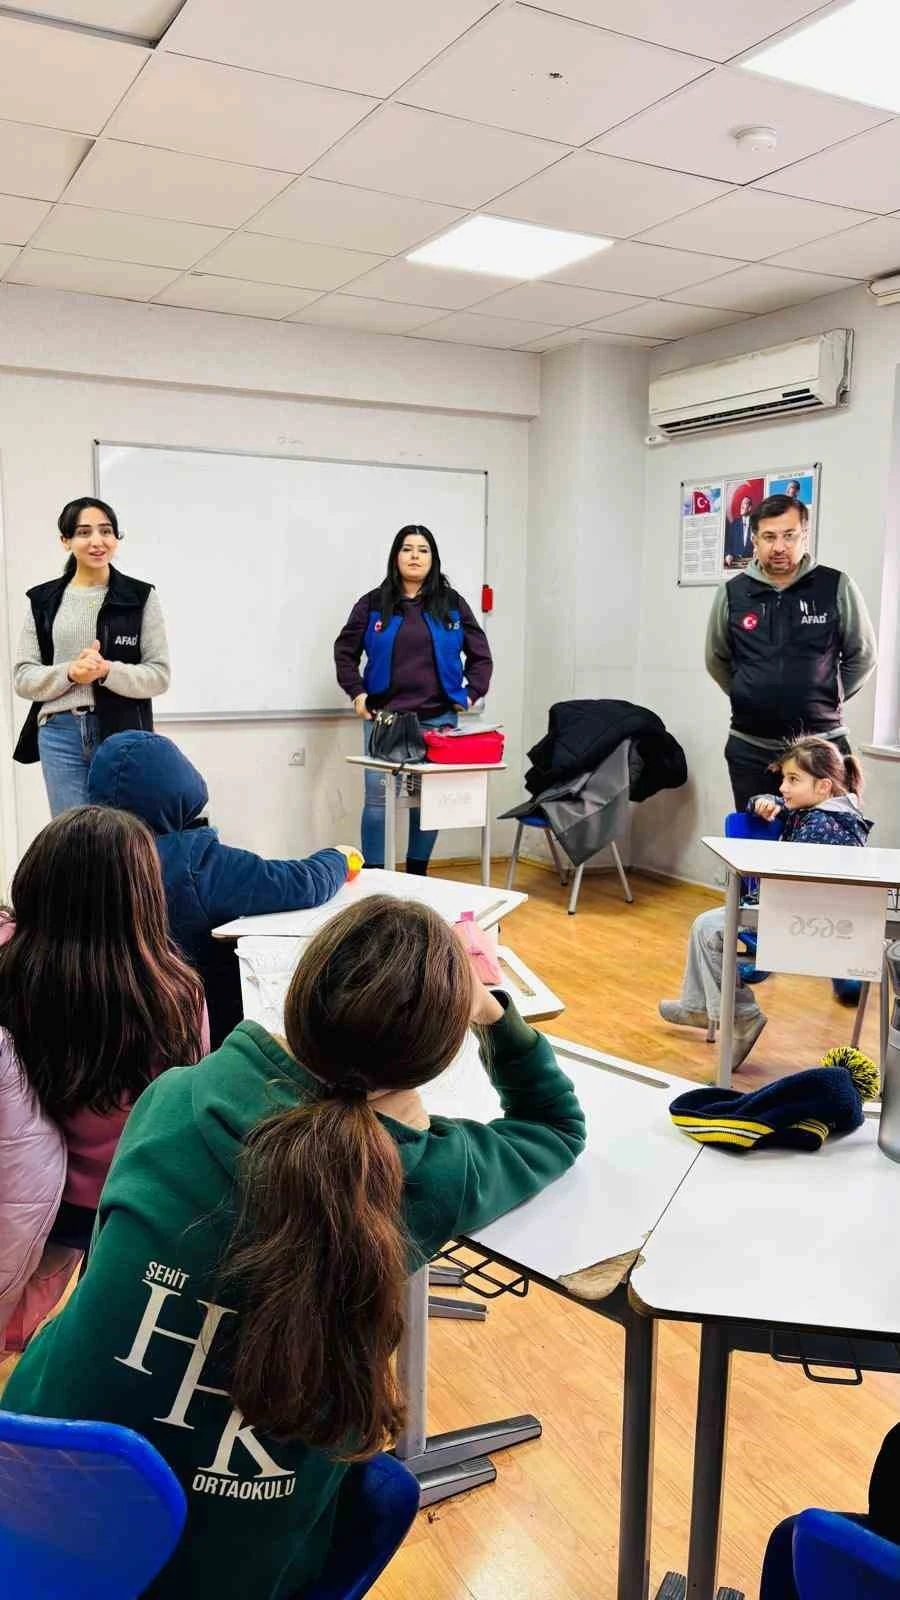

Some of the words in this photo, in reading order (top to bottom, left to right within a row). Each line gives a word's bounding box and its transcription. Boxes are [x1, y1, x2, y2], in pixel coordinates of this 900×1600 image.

[801, 614, 827, 624] AFAD
[115, 635, 138, 646] AFAD
[145, 1261, 190, 1289] ŞEHİT
[192, 1474, 296, 1500] ORTAOKULU
